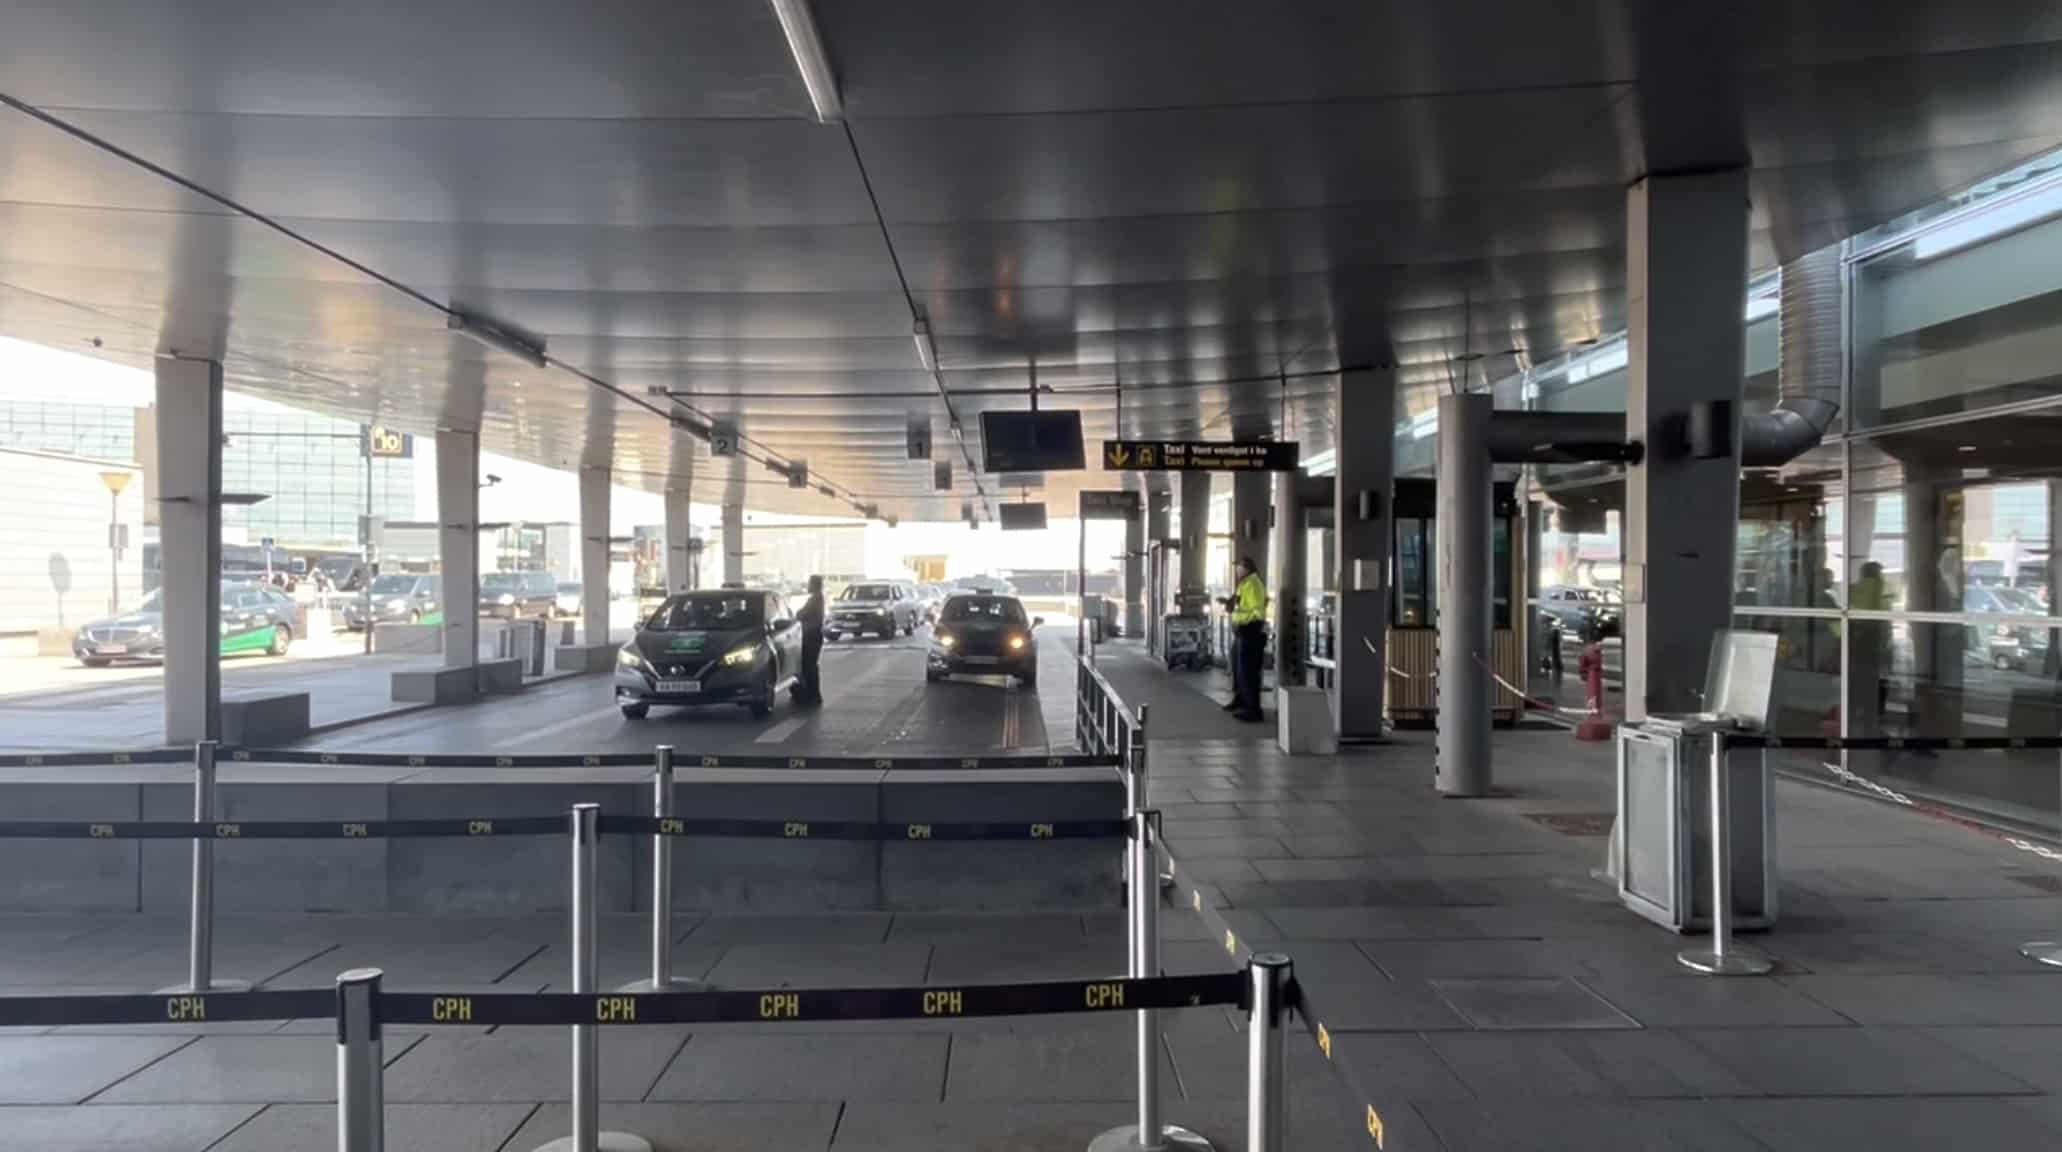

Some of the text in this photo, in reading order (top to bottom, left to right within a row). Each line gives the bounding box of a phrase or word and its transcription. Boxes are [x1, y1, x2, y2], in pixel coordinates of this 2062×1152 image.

[716, 439, 728, 453] 2
[1164, 443, 1185, 455] Taxi
[1164, 455, 1185, 466] Taxi
[90, 824, 113, 838] CPH
[216, 823, 240, 837] CPH
[343, 823, 367, 837] CPH
[469, 820, 492, 834] CPH
[660, 819, 684, 833] CPH
[784, 822, 808, 837] CPH
[908, 824, 931, 839] CPH
[1031, 823, 1053, 838] CPH
[924, 991, 962, 1015] CPH
[1086, 984, 1124, 1007] CPH
[167, 997, 205, 1020] CPH
[433, 998, 471, 1021] CPH
[597, 998, 635, 1021] CPH
[760, 995, 799, 1018] CPH
